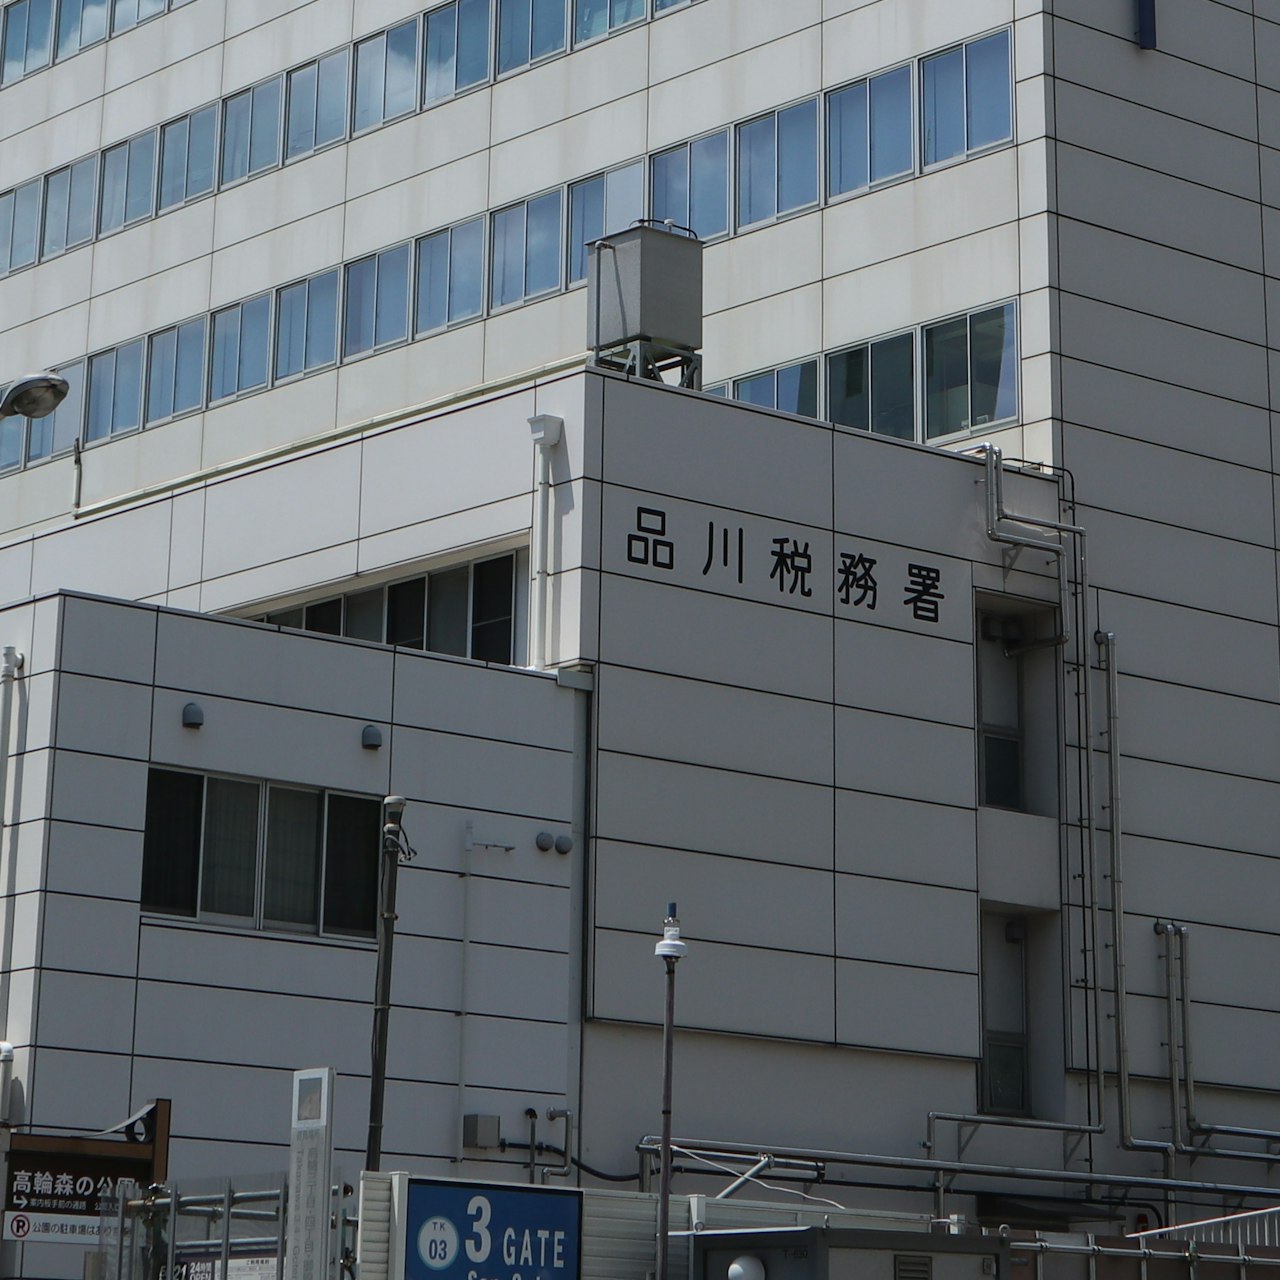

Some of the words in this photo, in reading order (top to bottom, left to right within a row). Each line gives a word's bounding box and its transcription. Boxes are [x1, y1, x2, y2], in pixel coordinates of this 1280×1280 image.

[626, 505, 946, 623] 品川税務署
[428, 1239, 448, 1261] 03
[431, 1221, 446, 1232] TK
[464, 1195, 492, 1264] 3
[502, 1227, 566, 1269] GATE
